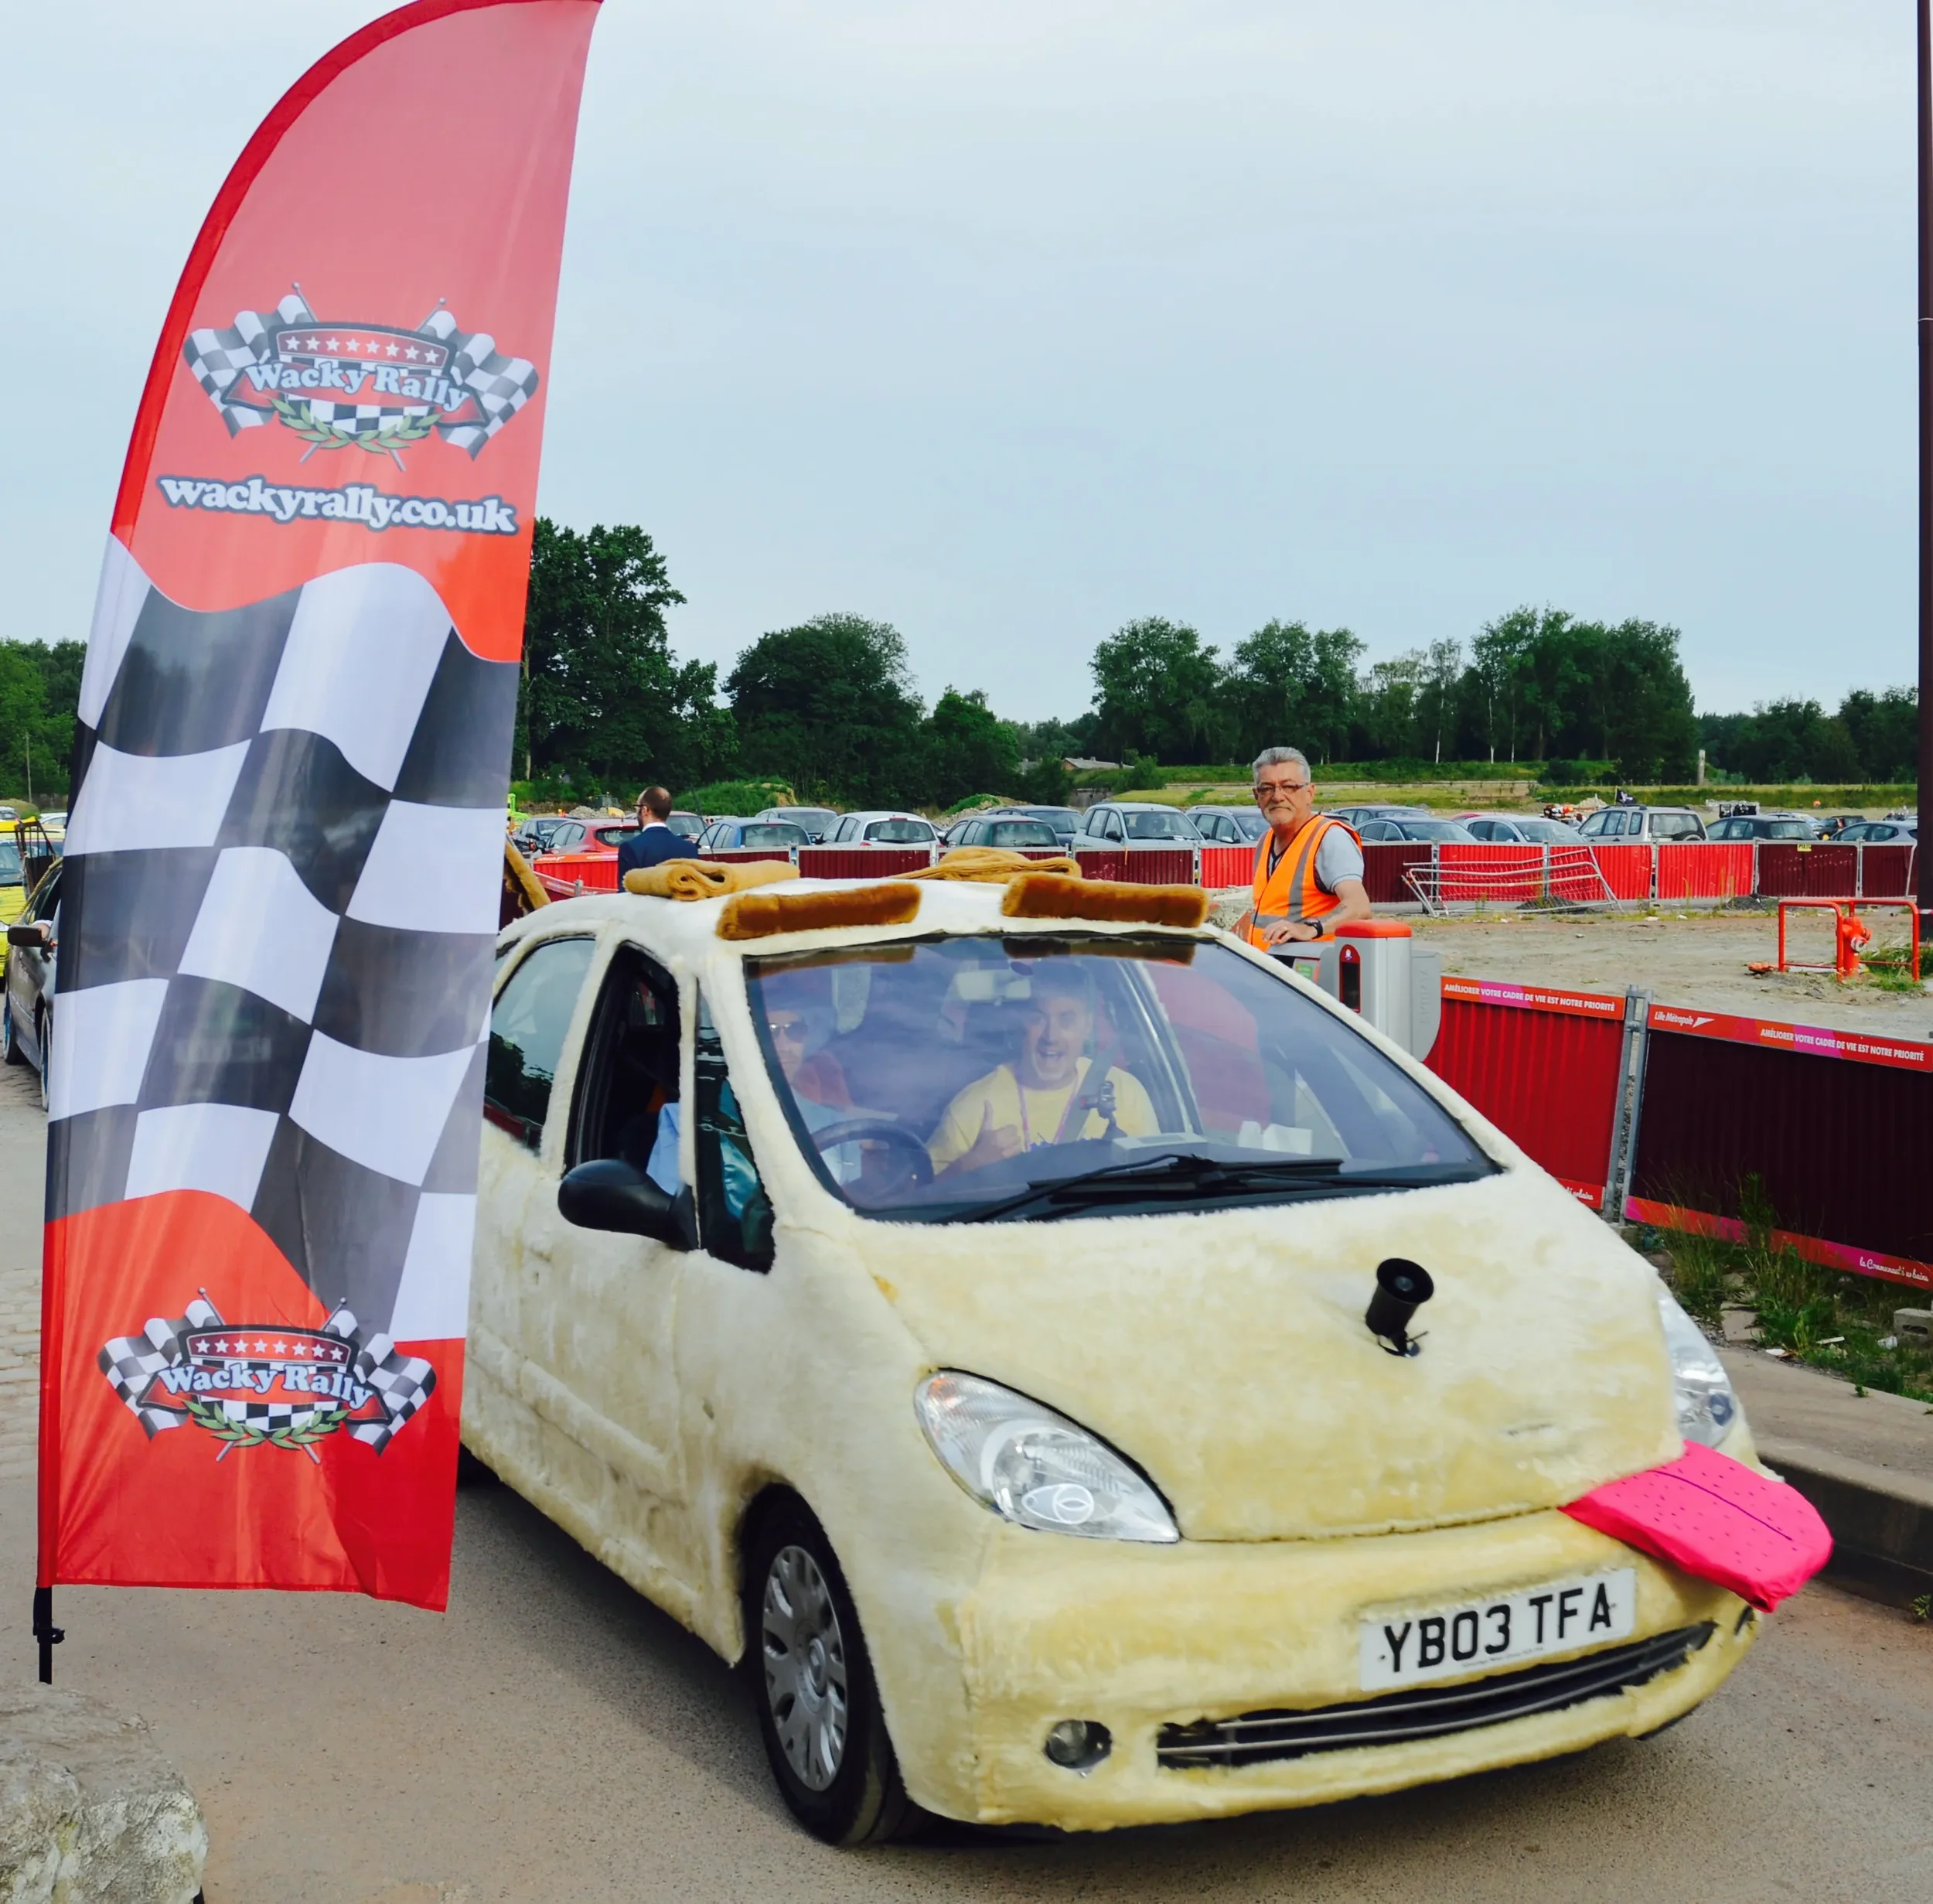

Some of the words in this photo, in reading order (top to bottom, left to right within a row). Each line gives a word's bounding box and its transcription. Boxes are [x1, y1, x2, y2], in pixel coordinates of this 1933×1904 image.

[244, 361, 367, 394] Wacky
[373, 365, 470, 412] Rally
[159, 477, 518, 534] wackyrally.co.uk
[1444, 984, 1480, 995] AMÉLIORER
[1481, 988, 1502, 998] VOTRE
[1502, 991, 1524, 1001] CADRE
[1535, 995, 1546, 1003] VIE
[1547, 995, 1560, 1005] EST
[1560, 998, 1583, 1008] NOTRE
[1584, 999, 1615, 1012] PRIORITÉ
[1655, 1011, 1665, 1021] Lille
[1665, 1012, 1694, 1026] Métropole
[1761, 1028, 1794, 1041] AMÉLIORER
[1795, 1033, 1815, 1045] VOTRE
[1815, 1037, 1836, 1049] CADRE
[1836, 1040, 1846, 1049] DE
[1846, 1042, 1856, 1052] VIE
[1858, 1044, 1870, 1053] EST
[1870, 1046, 1893, 1057] NOTRE
[1894, 1050, 1924, 1061] PRIORITÉ
[157, 1363, 278, 1395] Wacky
[284, 1364, 373, 1410] Rally
[1383, 1604, 1511, 1673] YB03
[1529, 1582, 1612, 1644] TFA
